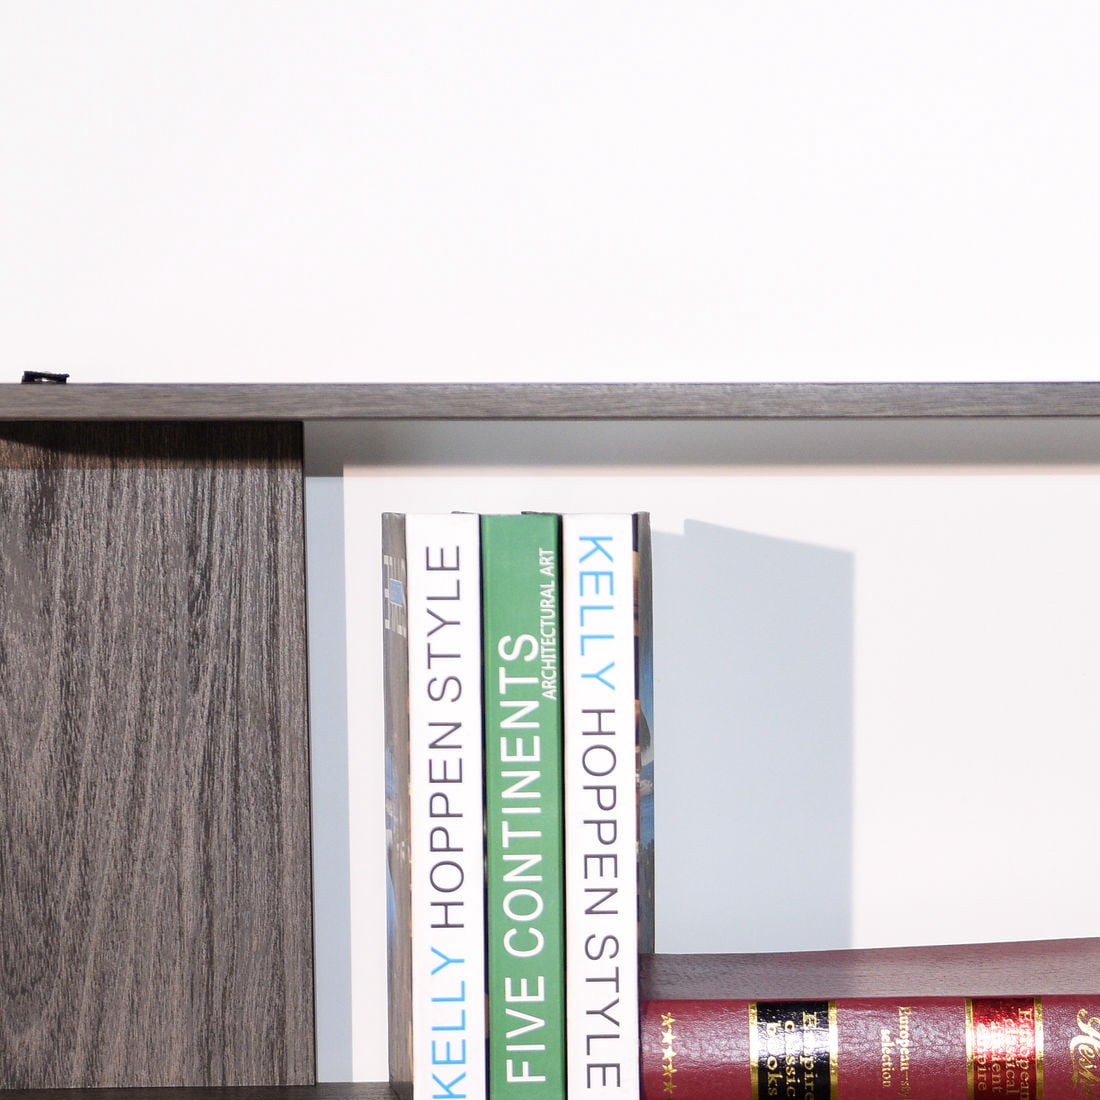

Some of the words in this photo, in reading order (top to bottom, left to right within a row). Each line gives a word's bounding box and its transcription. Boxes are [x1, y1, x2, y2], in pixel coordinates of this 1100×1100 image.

[426, 545, 463, 703] STYLE
[539, 547, 555, 577] ART
[578, 535, 616, 692] KELLY
[540, 580, 557, 700] ARCHITECTURAL
[428, 721, 465, 930] HOPPEN
[497, 632, 546, 959] CONTINENTS
[580, 708, 619, 916] HOPPEN
[430, 946, 467, 1100] KELLY
[505, 975, 546, 1084] FIVE
[583, 934, 621, 1090] STYLE
[766, 1020, 784, 1096] boks
[784, 1020, 801, 1096] cssic
[880, 1028, 895, 1088] selection
[991, 1021, 1005, 1093] aient
